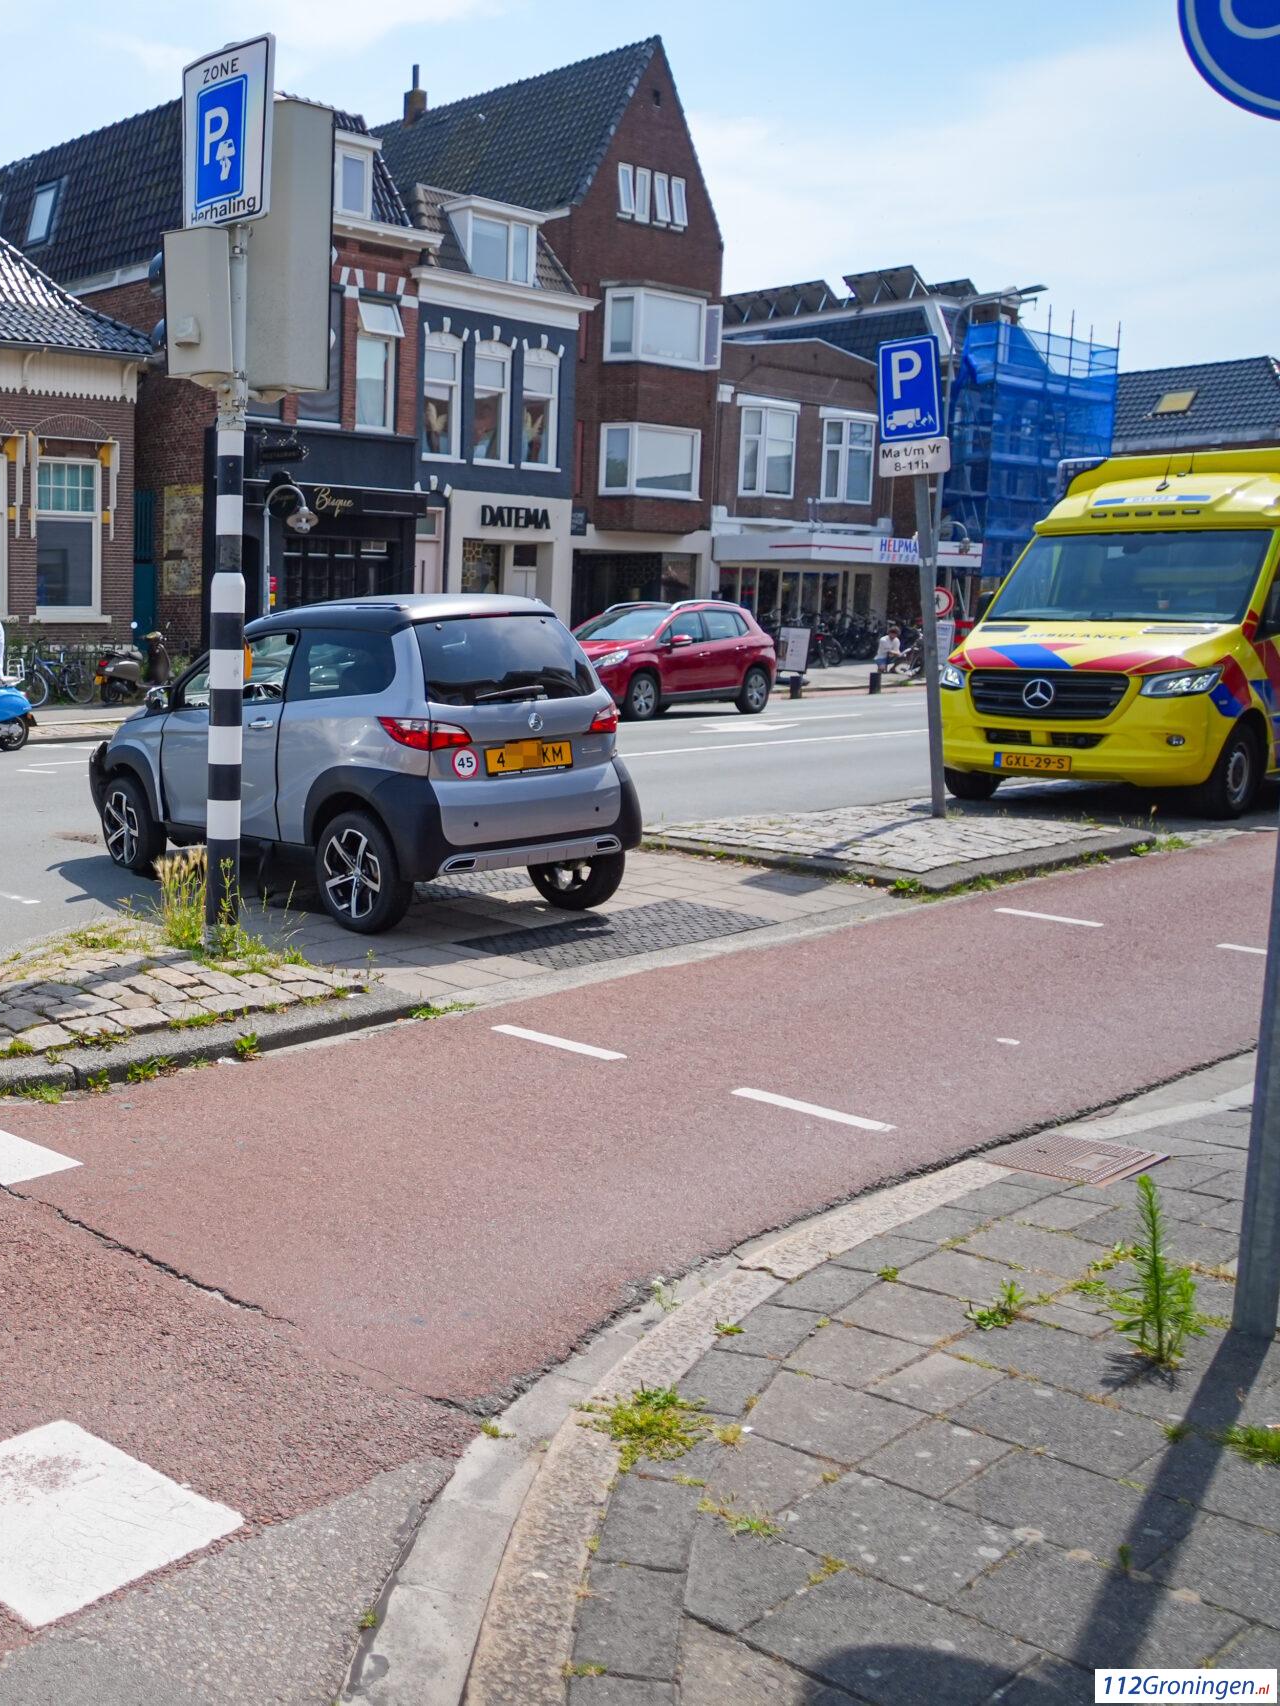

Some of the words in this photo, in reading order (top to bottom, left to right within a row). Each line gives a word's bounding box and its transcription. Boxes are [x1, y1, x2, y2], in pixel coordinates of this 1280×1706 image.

[203, 58, 239, 84] ZONE
[203, 106, 229, 166] P
[191, 196, 256, 225] Herhaling
[891, 350, 922, 399] P
[882, 448, 900, 459] Ma
[904, 446, 925, 457] t/m
[928, 443, 941, 454] Vr
[894, 460, 929, 472] 8-11h
[313, 487, 354, 517] Bisque
[481, 505, 551, 529] DATEMA
[880, 538, 918, 553] HELPMA
[457, 756, 474, 768] 45
[1005, 755, 1065, 769] GXL-29-S
